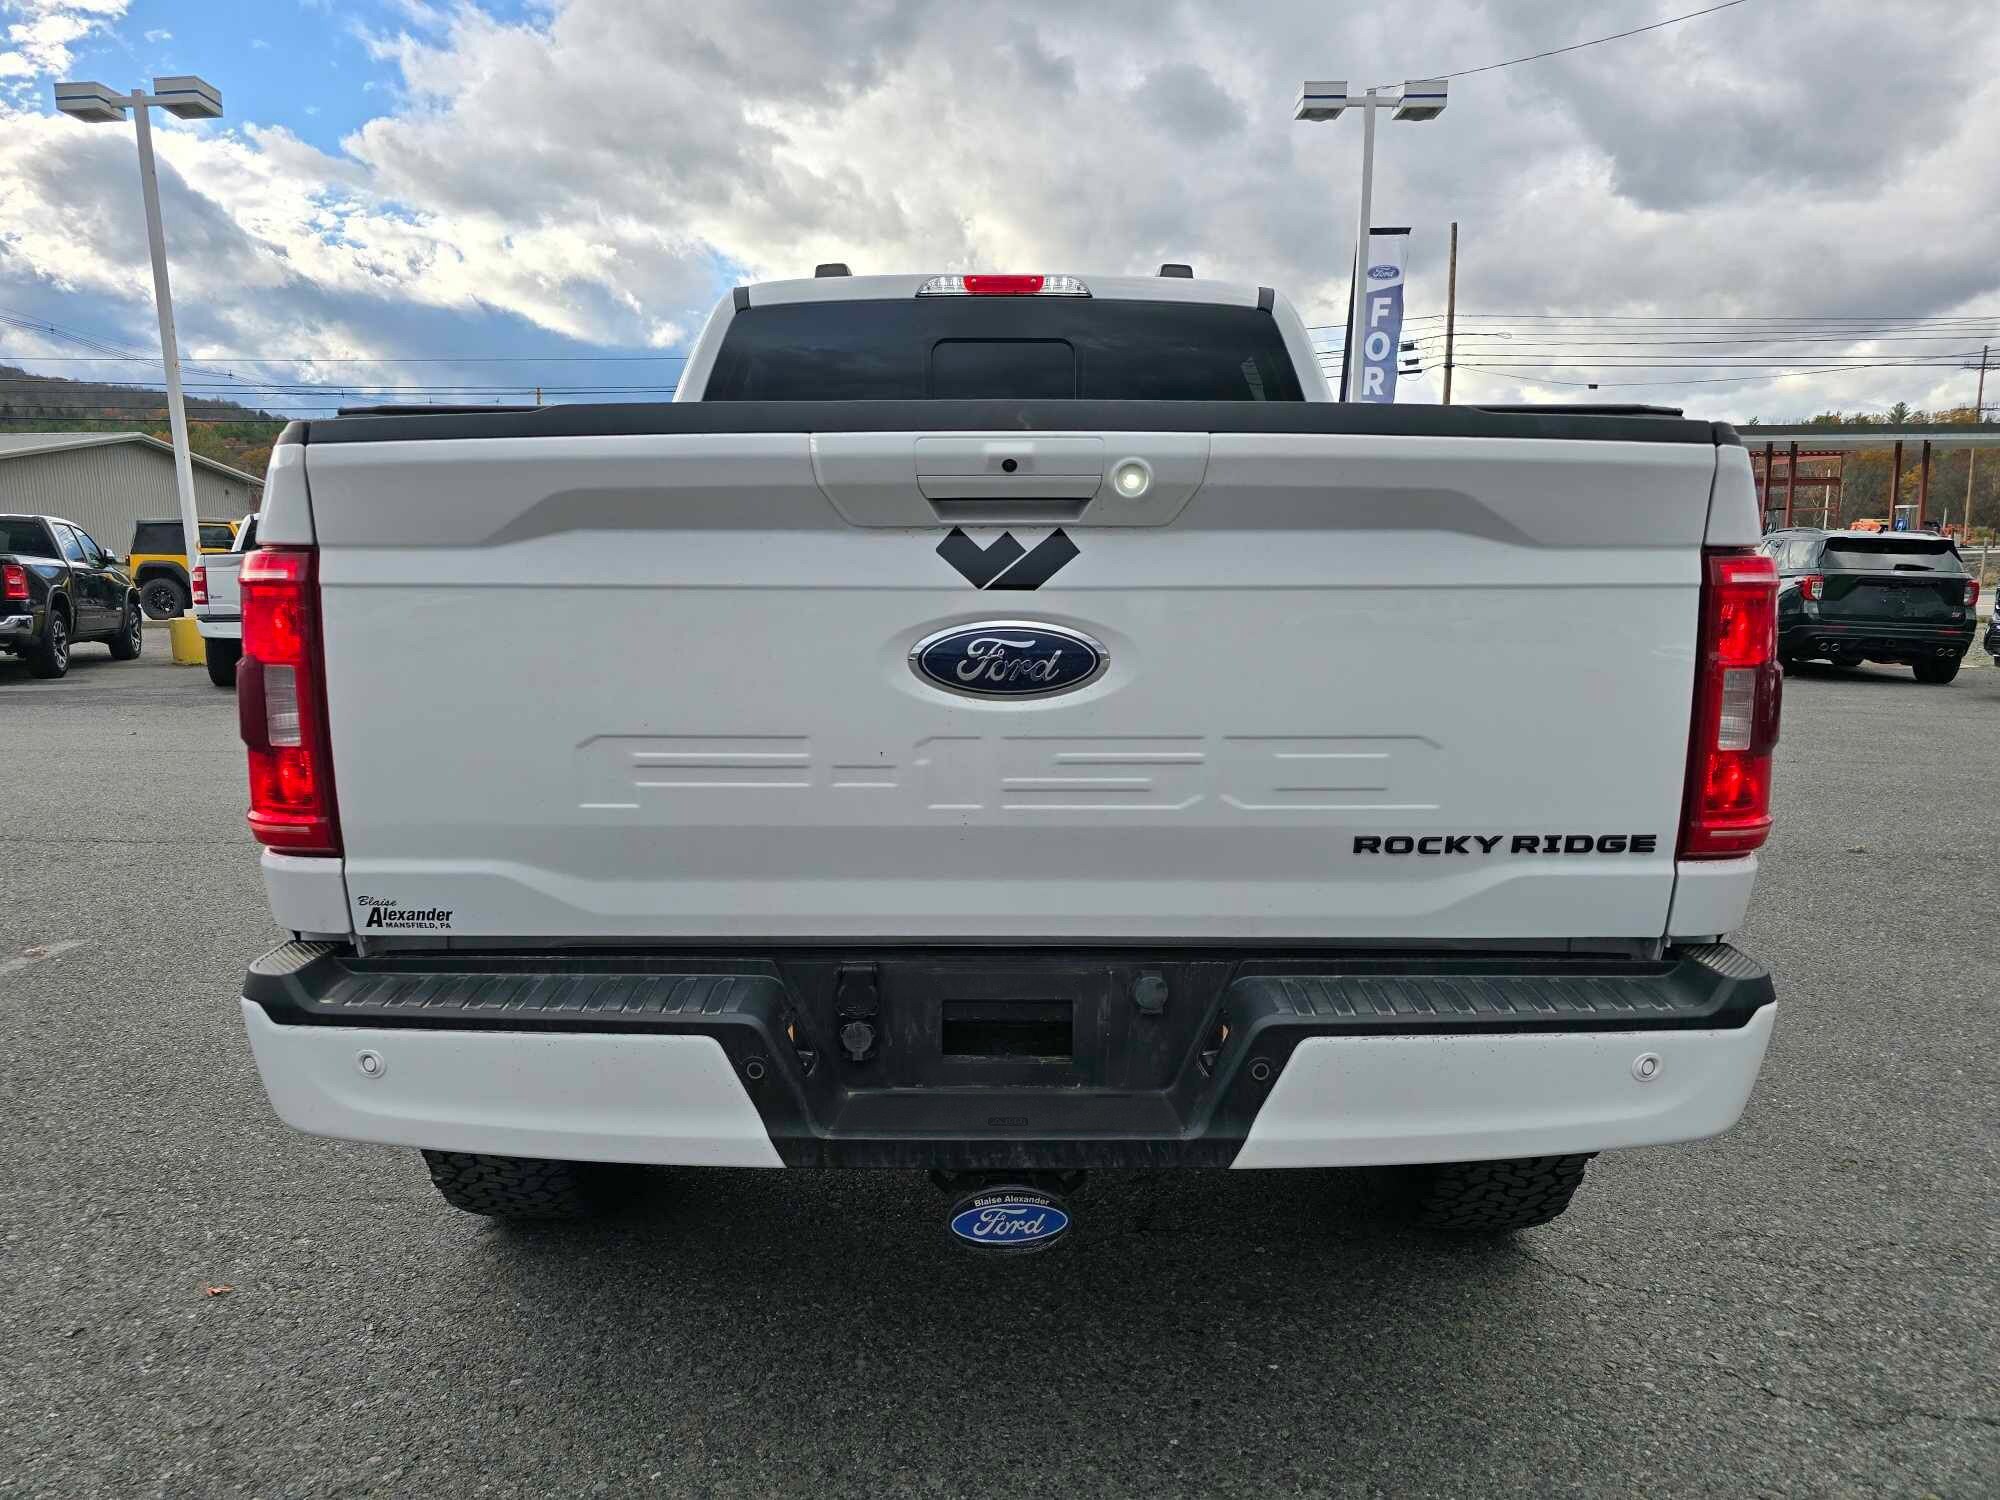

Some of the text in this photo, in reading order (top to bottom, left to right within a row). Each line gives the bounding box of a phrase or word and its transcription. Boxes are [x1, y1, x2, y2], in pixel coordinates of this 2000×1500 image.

[1361, 297, 1392, 403] FOR
[956, 638, 1062, 681] Ford
[575, 734, 1443, 810] F-150
[1352, 834, 1657, 855] ROCKY RIDGE
[357, 895, 397, 907] Blaise
[366, 906, 453, 928] Alexander
[974, 1195, 1050, 1207] Blaise Alexander
[973, 1208, 1046, 1236] Ford
